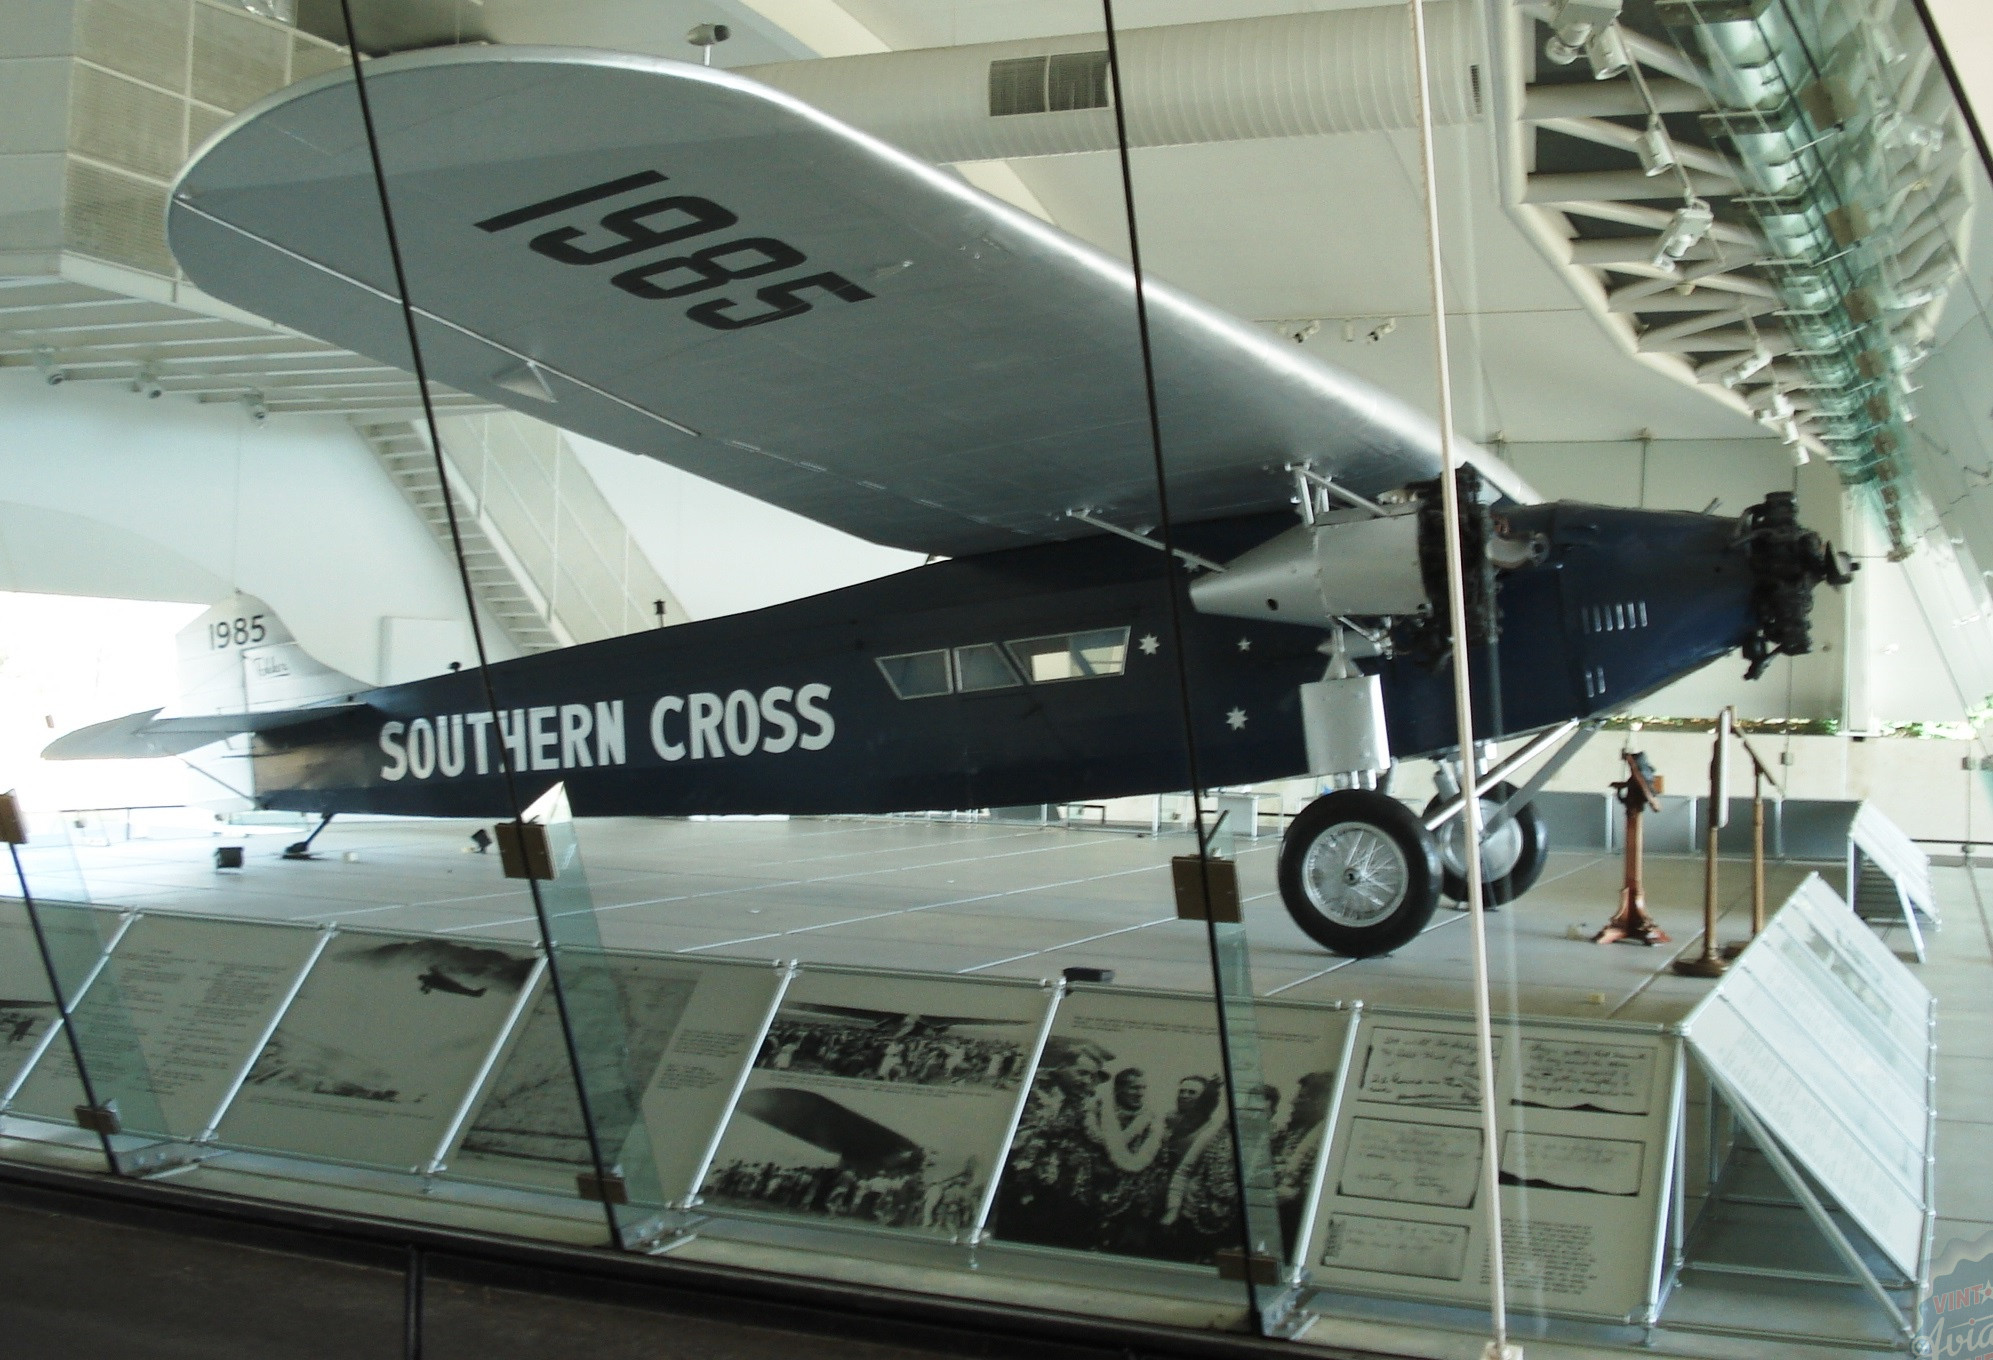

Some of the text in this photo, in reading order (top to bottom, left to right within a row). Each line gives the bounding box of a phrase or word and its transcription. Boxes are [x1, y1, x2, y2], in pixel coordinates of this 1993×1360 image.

[473, 170, 876, 330] 1985
[209, 614, 265, 650] 1985
[379, 683, 836, 781] SOUTHERN CROSS
